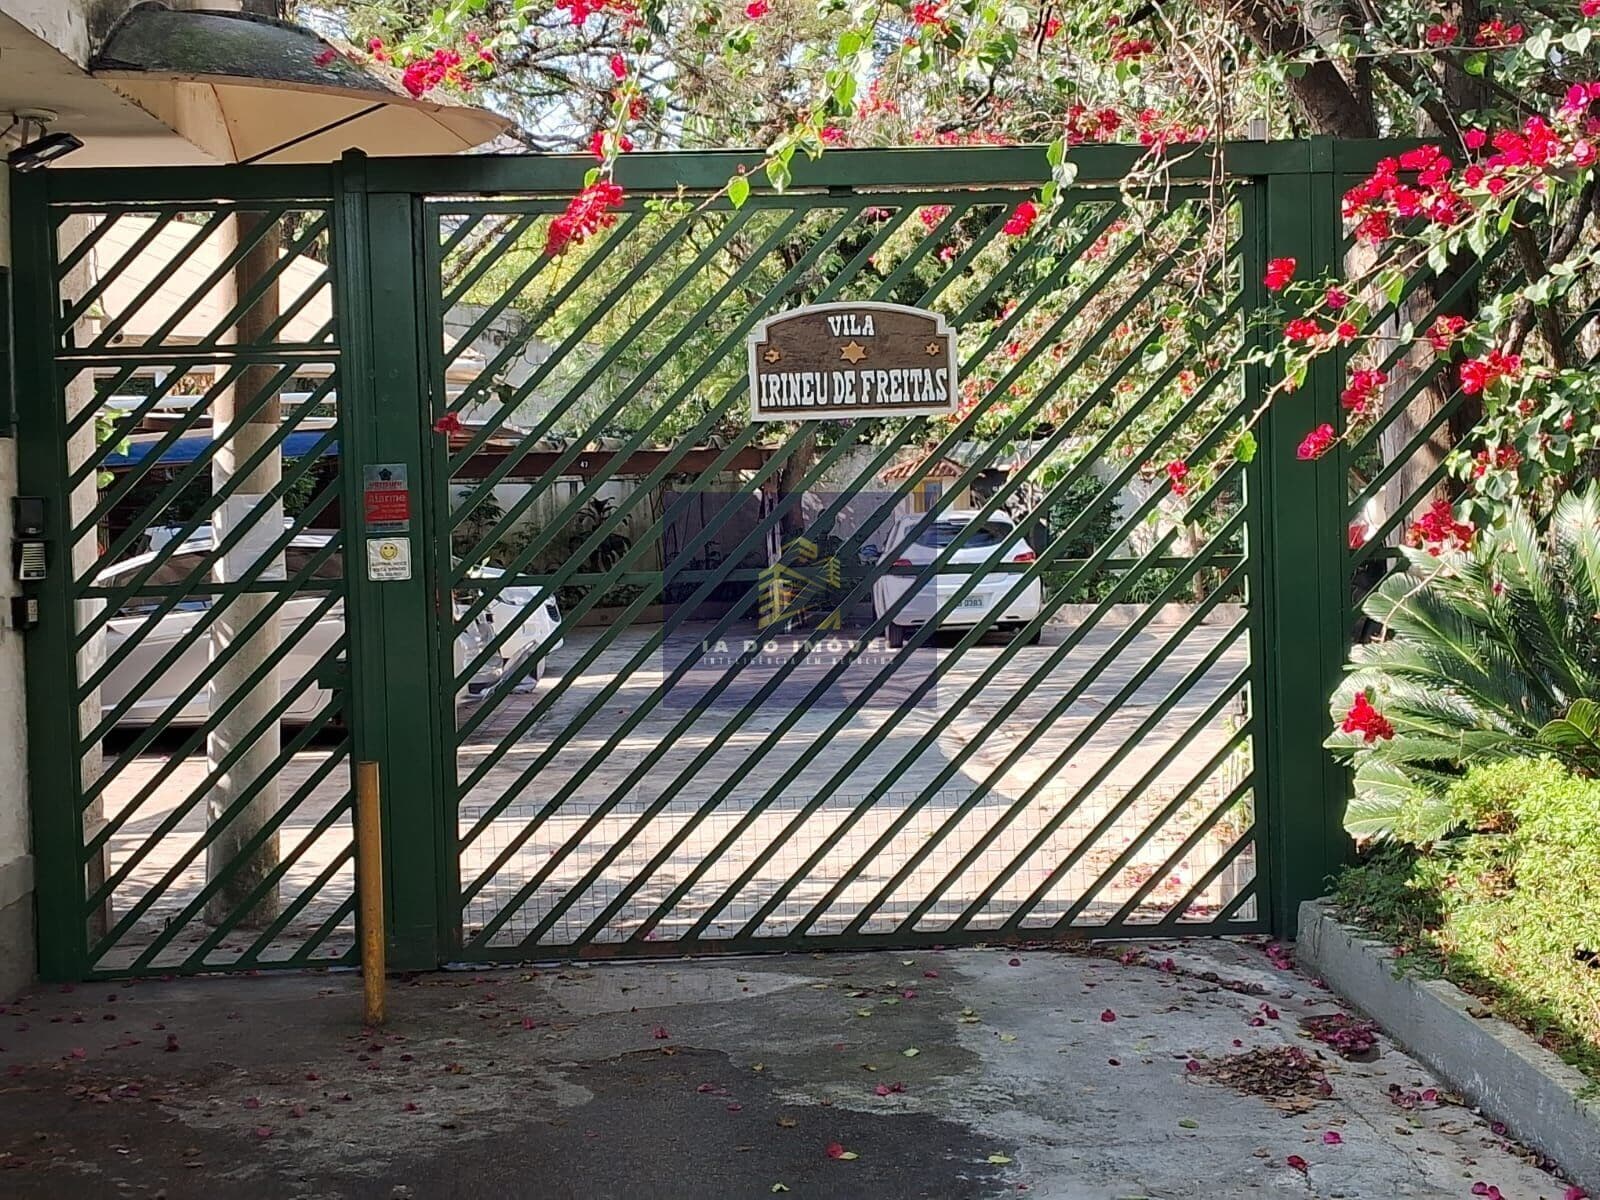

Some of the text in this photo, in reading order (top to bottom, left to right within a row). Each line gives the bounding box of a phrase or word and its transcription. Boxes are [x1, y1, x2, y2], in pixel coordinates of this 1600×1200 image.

[827, 314, 875, 337] VILA
[759, 367, 948, 407] IRINEU DE FREITAS
[368, 493, 406, 504] Alarme
